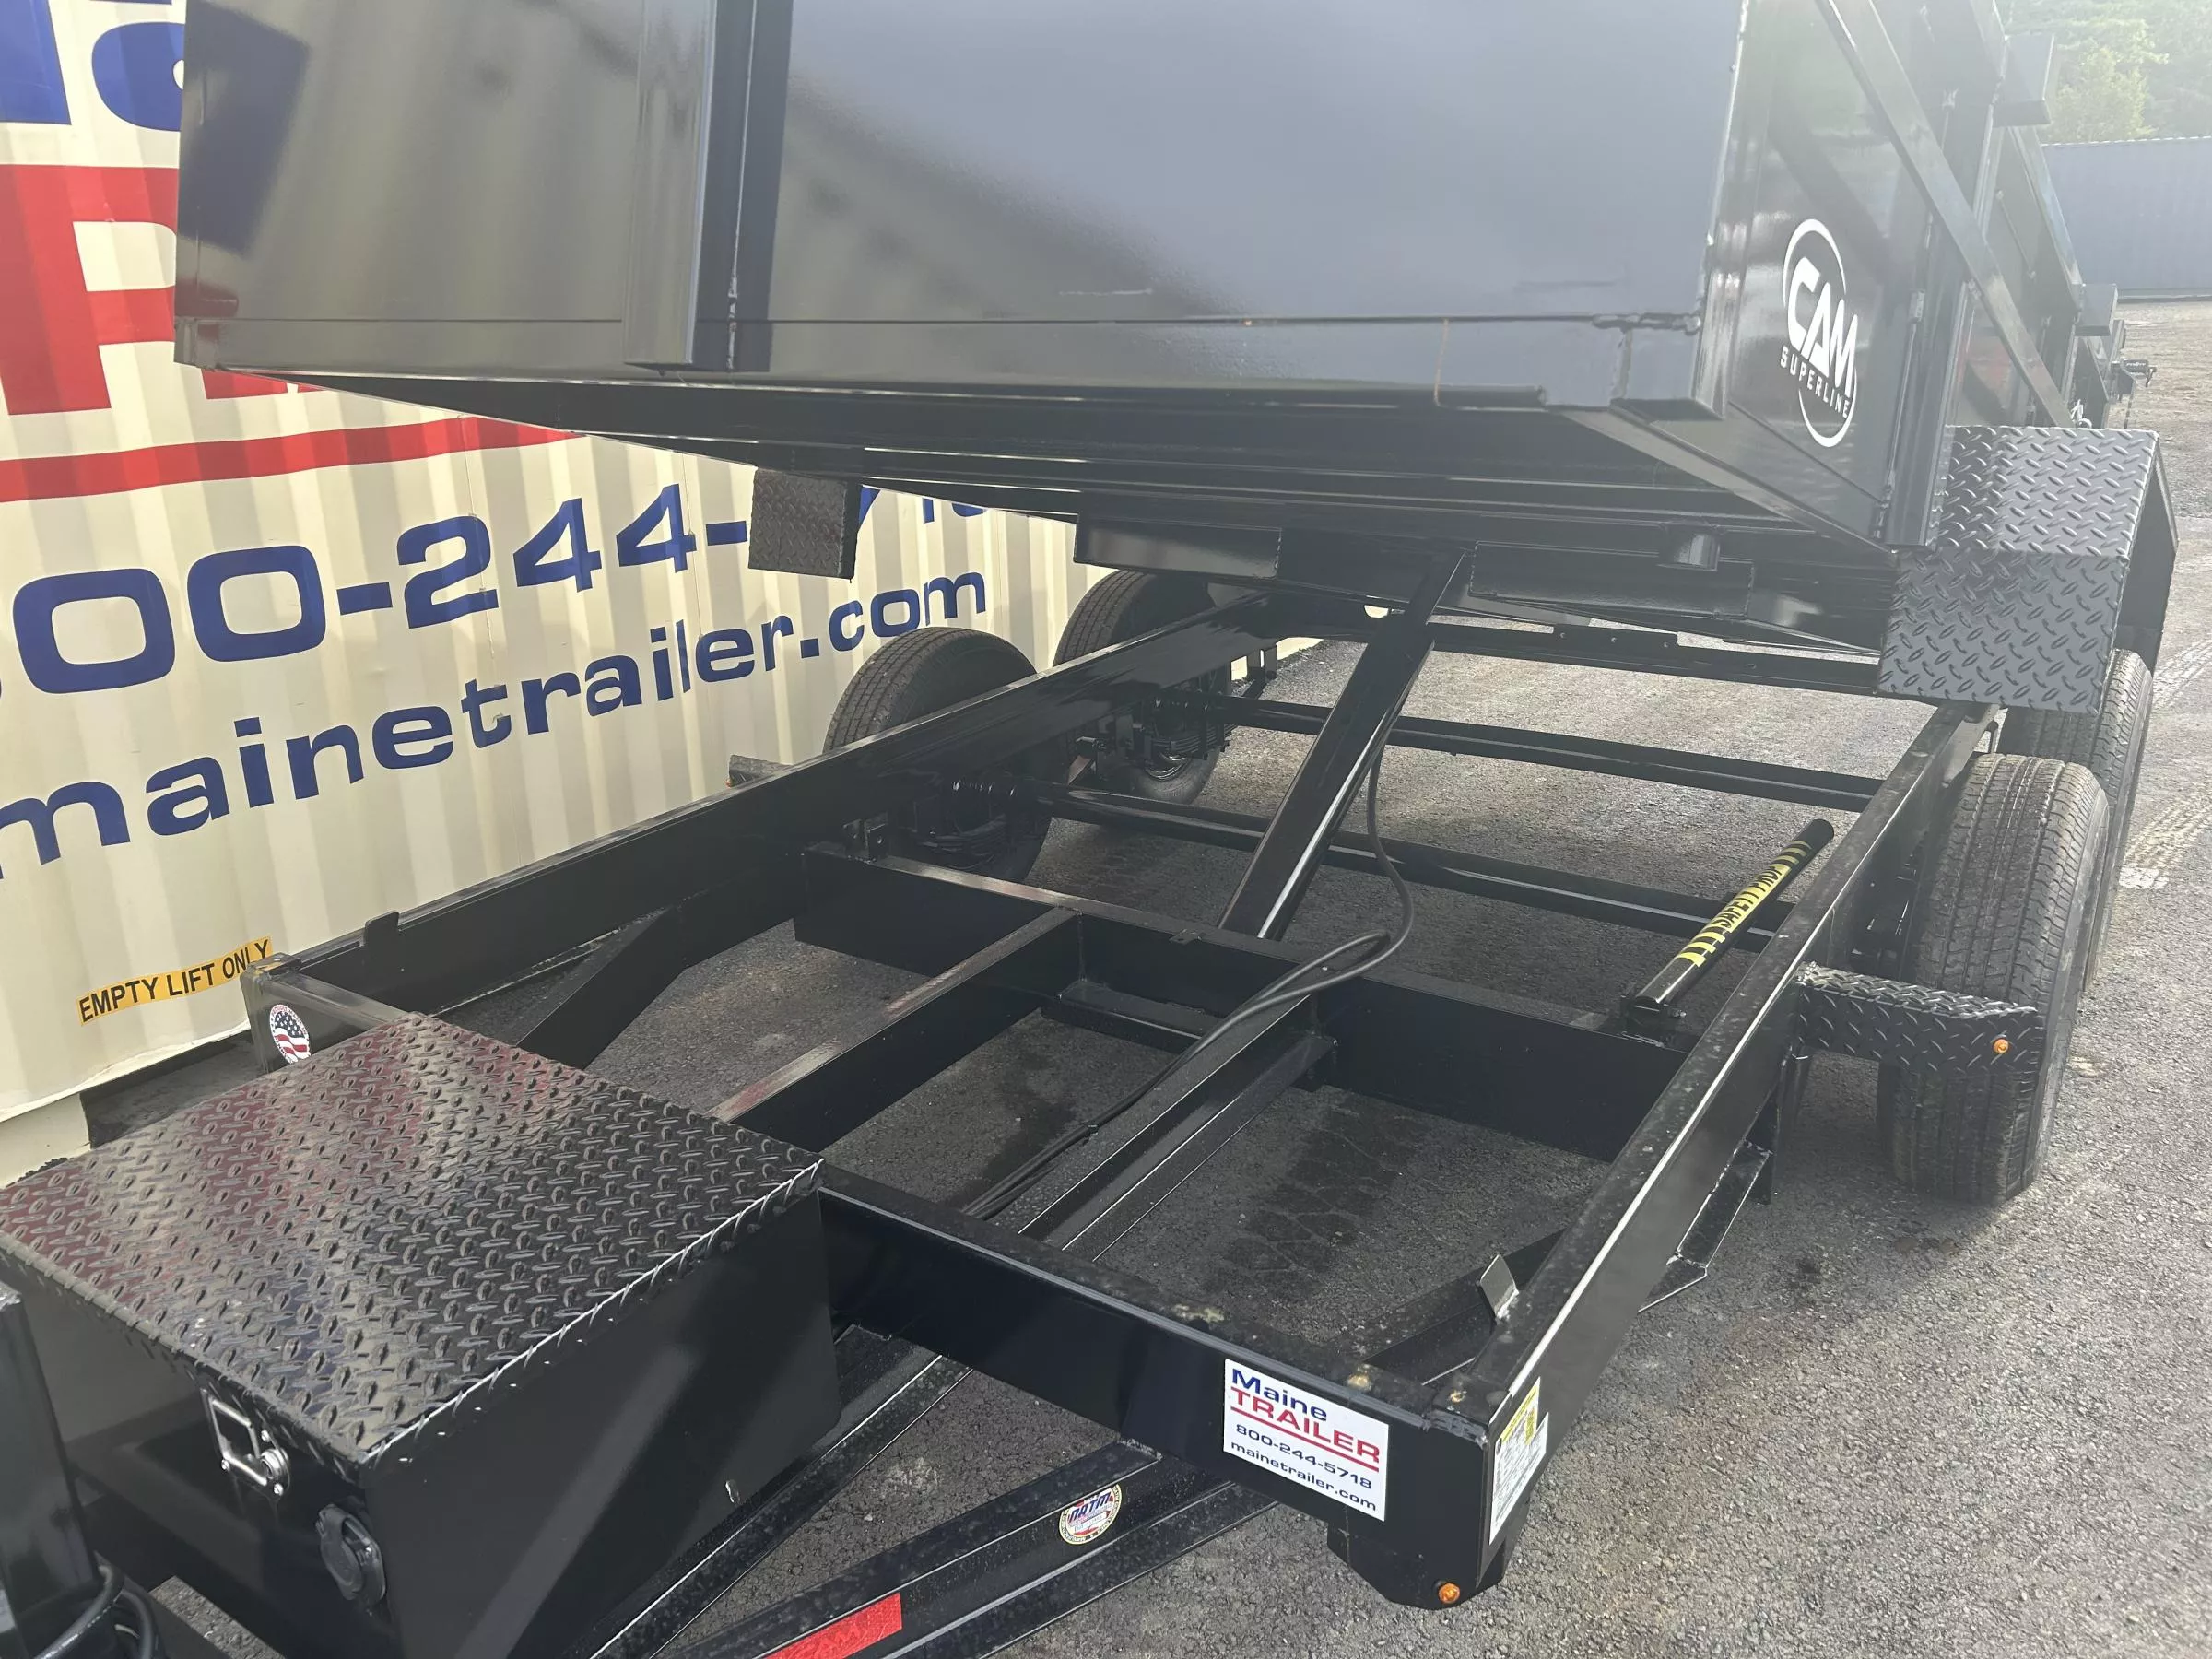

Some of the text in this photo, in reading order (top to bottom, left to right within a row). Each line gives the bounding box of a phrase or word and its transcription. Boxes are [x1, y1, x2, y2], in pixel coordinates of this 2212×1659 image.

[1787, 257, 1858, 398] CAM
[1781, 346, 1852, 418] SUPERLINE
[0, 572, 986, 878] mainetrailer.com
[79, 977, 159, 1022] EMPTY
[167, 963, 215, 996] LIFT
[1230, 1386, 1380, 1464] TRAILER
[1231, 1368, 1327, 1421] Maine
[1230, 1441, 1377, 1512] mainetrailer.com
[1236, 1423, 1372, 1489] 800-244-5718
